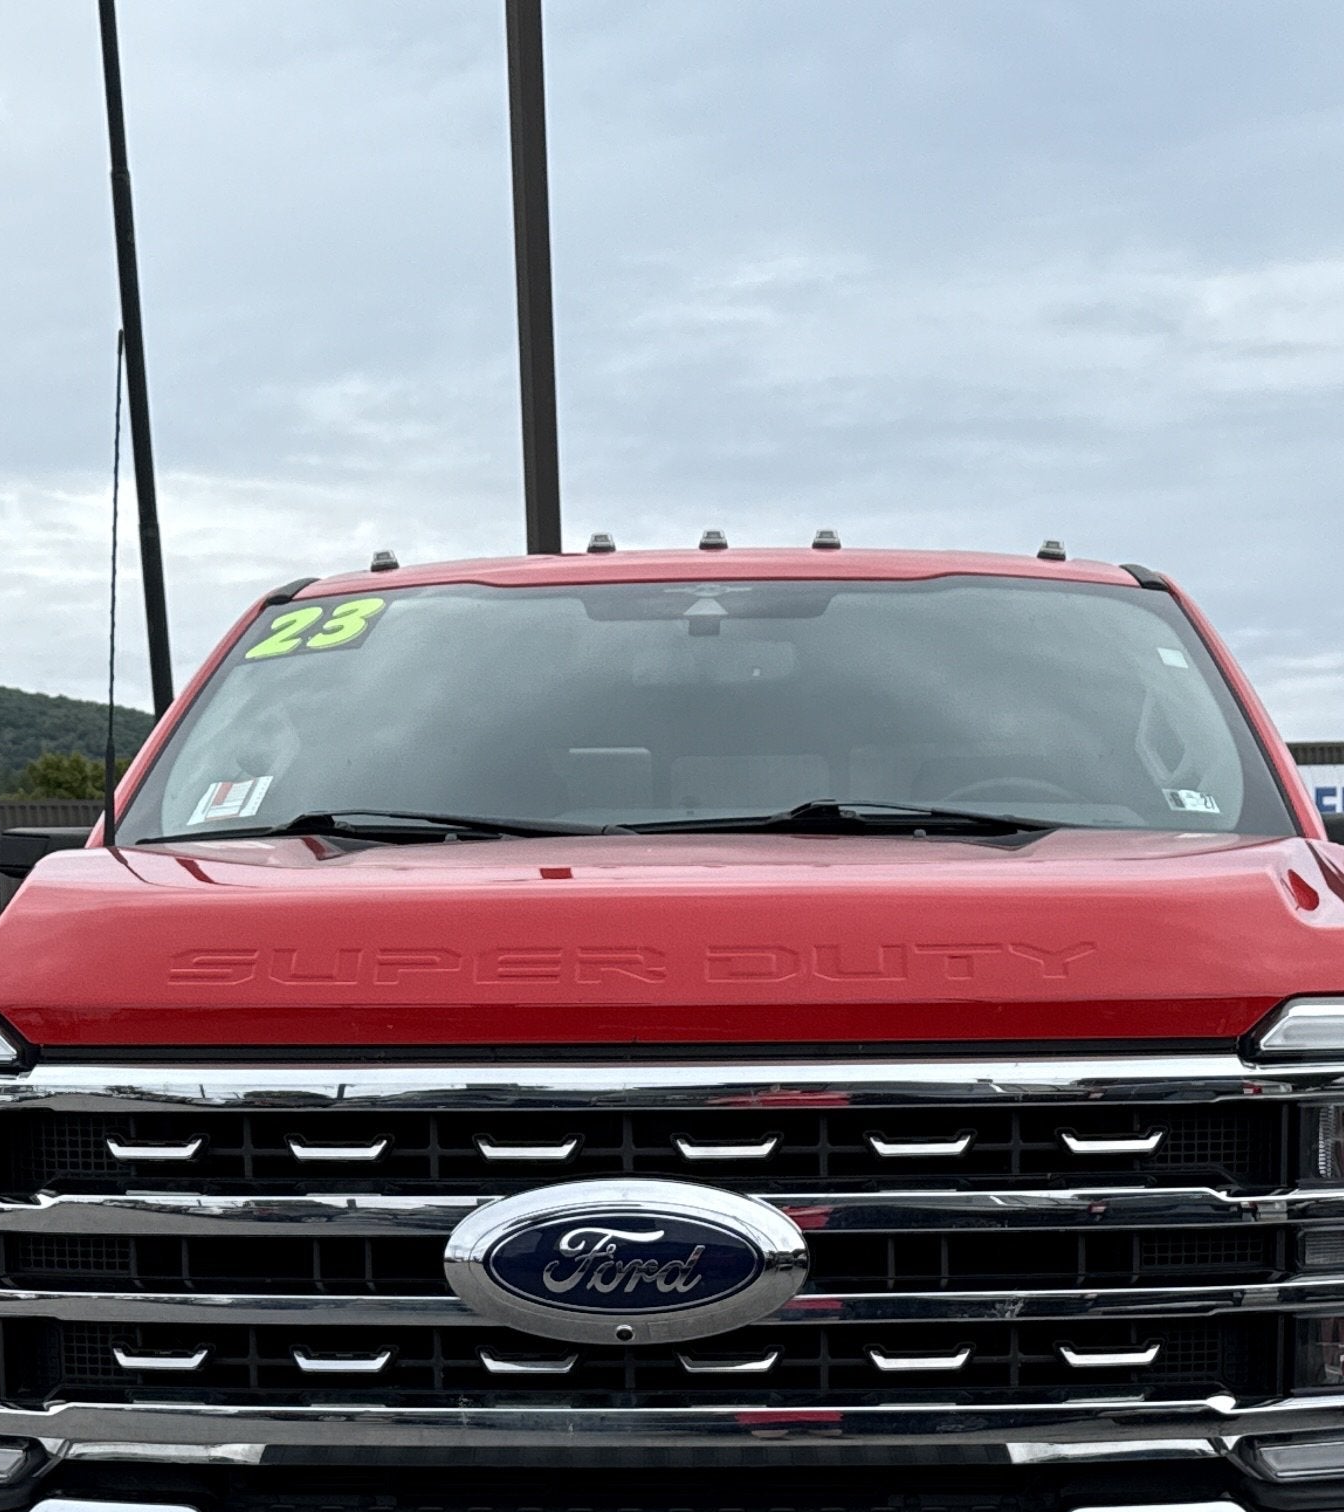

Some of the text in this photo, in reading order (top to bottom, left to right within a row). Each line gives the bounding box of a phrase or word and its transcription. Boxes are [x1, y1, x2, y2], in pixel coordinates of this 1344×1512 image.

[245, 598, 387, 659] 23
[167, 940, 1098, 986] SUPER DUTY
[542, 1226, 706, 1294] Ford
